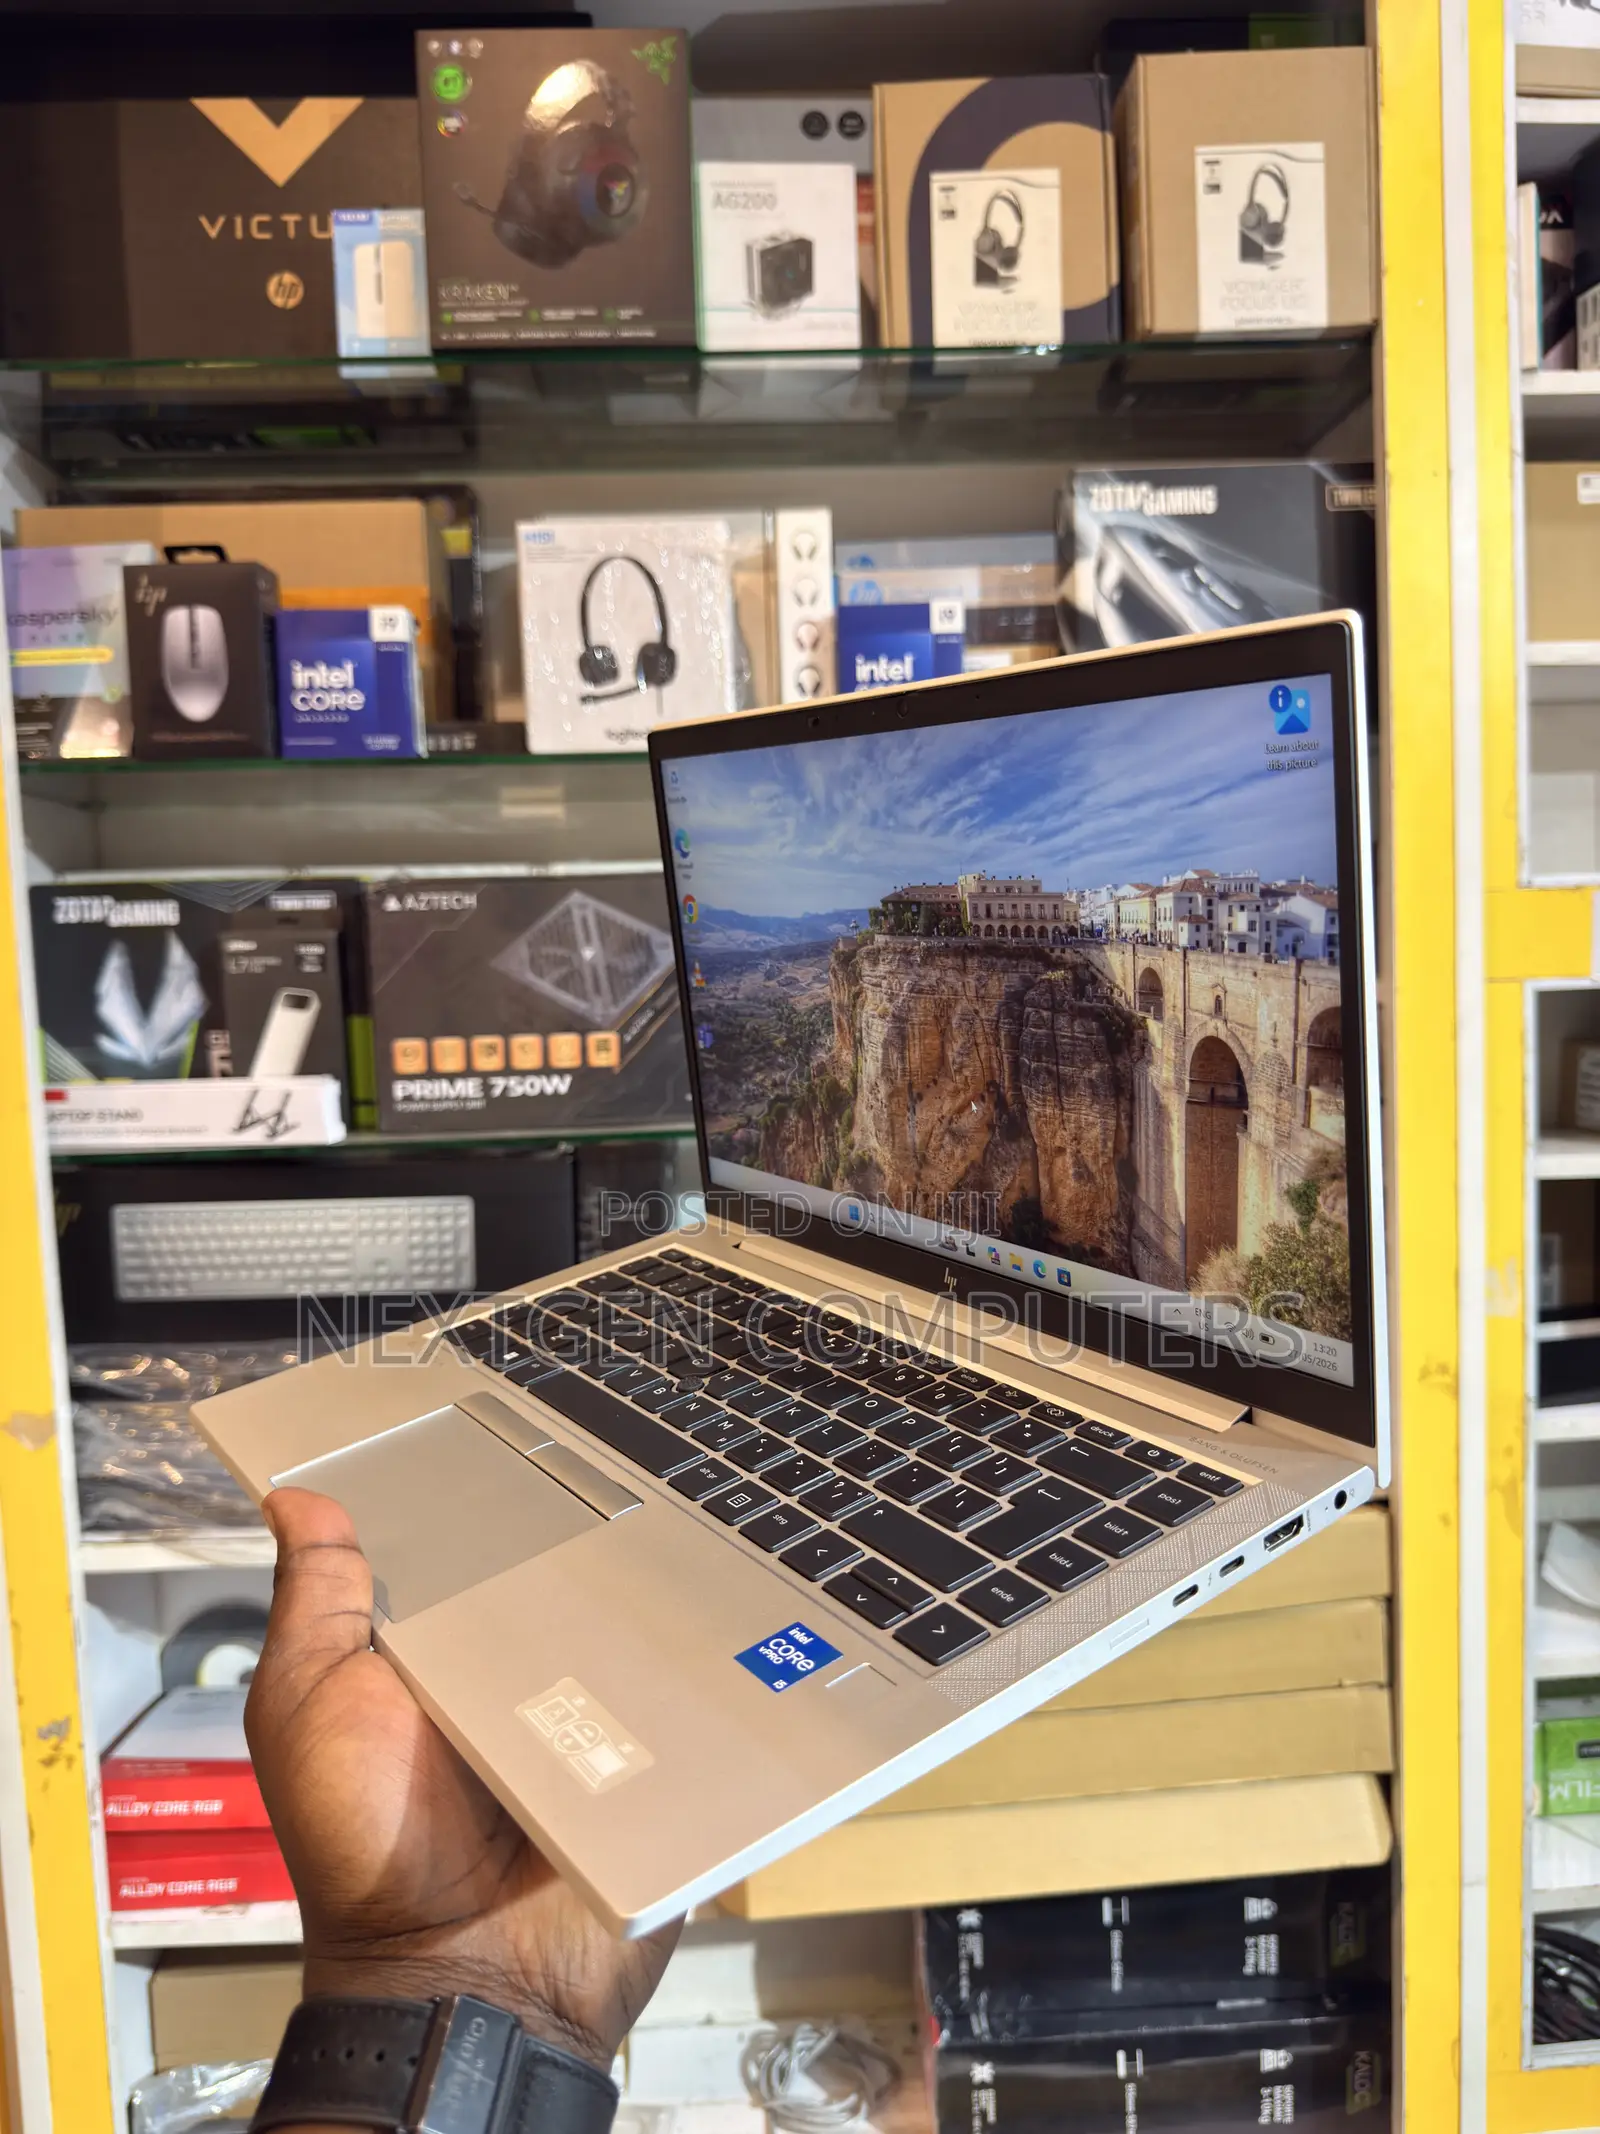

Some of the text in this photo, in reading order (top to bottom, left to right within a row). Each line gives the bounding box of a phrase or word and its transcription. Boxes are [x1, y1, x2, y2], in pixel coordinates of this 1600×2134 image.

[198, 213, 334, 240] VICTU
[290, 659, 355, 689] intel
[855, 653, 914, 682] intel
[1264, 740, 1319, 754] Learn about
[1267, 758, 1318, 772] this picture
[402, 891, 477, 911] AZTECH
[392, 1074, 573, 1101] PRIME 750W
[1312, 1342, 1338, 1358] 13:20
[719, 1373, 736, 1383] H
[653, 1386, 667, 1396] B
[685, 1402, 702, 1412] N
[785, 1406, 802, 1416] K
[717, 1420, 735, 1431] M
[821, 1426, 834, 1436] L
[1089, 1425, 1116, 1439] druck
[1187, 1436, 1218, 1451] BANG
[1229, 1451, 1280, 1475] OLUFSEN
[1198, 1469, 1222, 1483] entf
[772, 1512, 789, 1526] strg
[990, 1585, 1015, 1603] ende
[788, 1627, 814, 1645] intel
[758, 1645, 785, 1665] vPRO
[772, 1678, 788, 1690] i5
